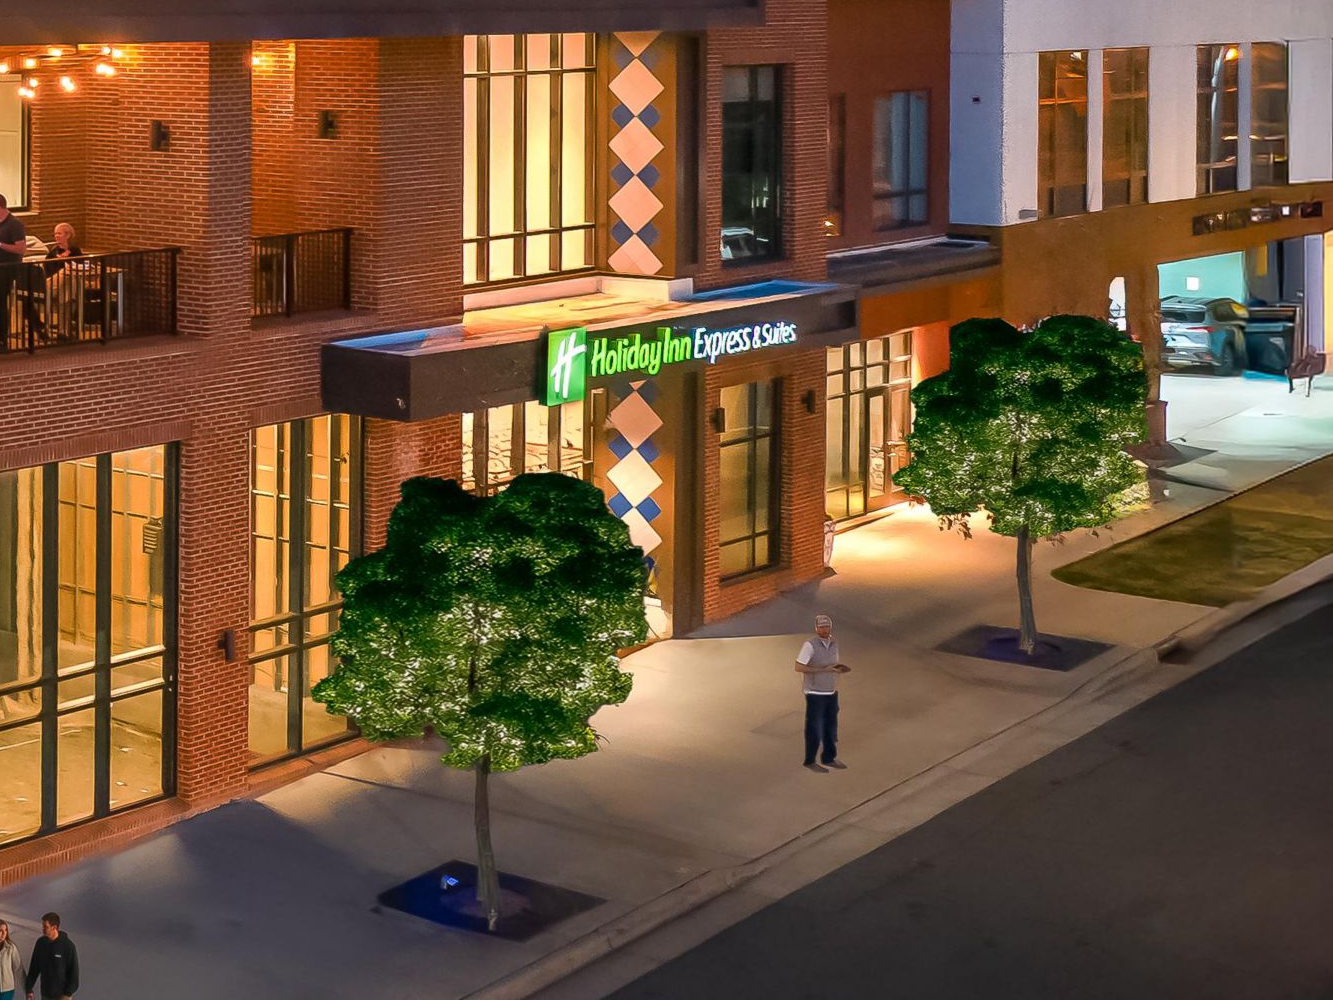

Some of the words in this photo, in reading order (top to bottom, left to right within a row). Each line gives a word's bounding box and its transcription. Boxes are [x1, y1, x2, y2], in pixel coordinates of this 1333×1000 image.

[591, 333, 663, 376] Holiday
[664, 327, 691, 363] Inn
[693, 326, 750, 363] Express
[752, 325, 763, 349] &
[763, 321, 797, 344] Suites
